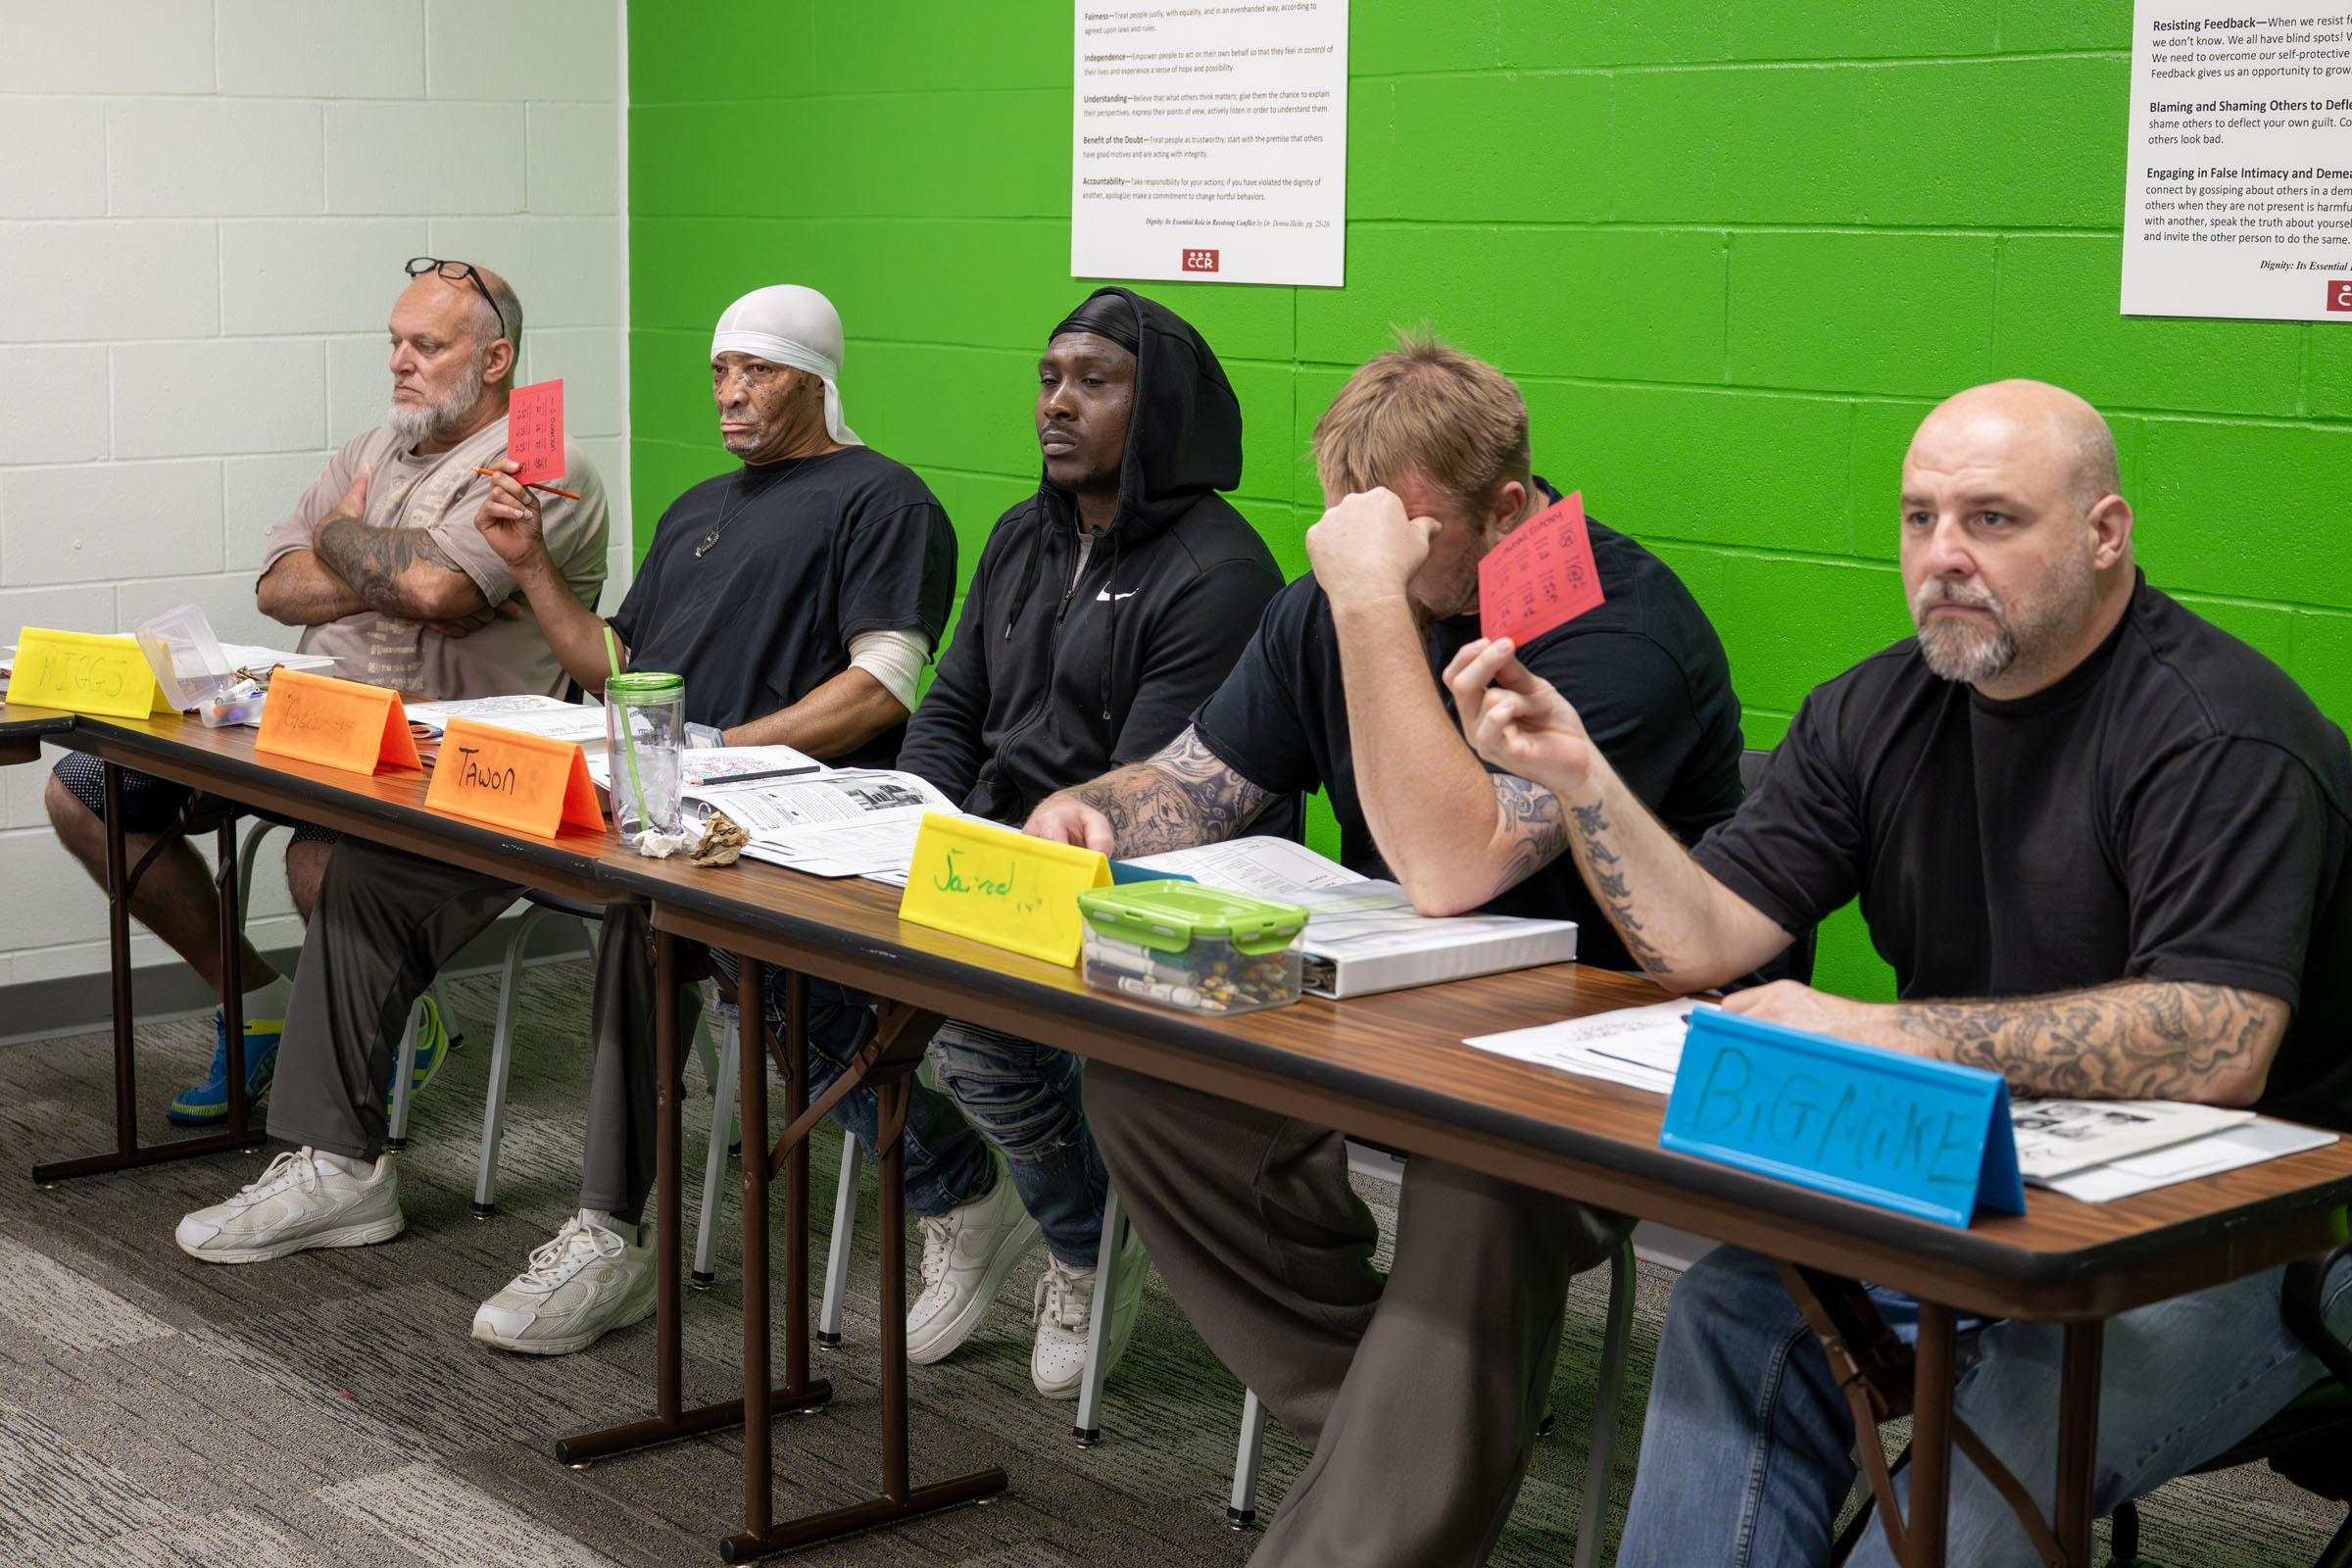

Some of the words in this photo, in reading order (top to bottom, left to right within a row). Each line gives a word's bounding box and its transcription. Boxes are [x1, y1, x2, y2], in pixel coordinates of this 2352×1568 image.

[2153, 19, 2200, 34] Resisting
[2300, 18, 2314, 26] we
[2317, 14, 2343, 25] resist
[2168, 36, 2193, 46] don’t
[2196, 35, 2224, 46] know.
[2228, 34, 2243, 45] We
[2246, 34, 2257, 44] all
[2260, 33, 2283, 44] have
[2286, 32, 2310, 43] blind
[2313, 31, 2343, 44] spots!
[2152, 52, 2167, 63] We
[2170, 52, 2193, 62] need
[2196, 51, 2206, 61] to
[2208, 53, 2256, 61] overcome
[2278, 48, 2350, 62] self-protective
[2151, 67, 2195, 78] Feedback
[2197, 67, 2221, 79] gives
[2251, 65, 2309, 78] opportunity
[2313, 65, 2323, 75] to
[2325, 67, 2352, 77] grow.
[2150, 101, 2192, 115] Blaming
[2196, 101, 2216, 112] and
[2219, 100, 2266, 114] Shaming
[2270, 100, 2307, 111] Others
[2310, 99, 2322, 110] to
[2149, 119, 2179, 129] shame
[2182, 118, 2212, 128] others
[2215, 118, 2225, 128] to
[2227, 118, 2260, 128] deflect
[2263, 120, 2285, 130] your
[2311, 117, 2336, 130] guilt.
[2148, 134, 2178, 144] others
[2180, 134, 2200, 144] look
[2203, 134, 2223, 144] bad.
[2147, 167, 2194, 180] Engaging
[2197, 167, 2207, 178] in
[2210, 167, 2237, 178] False
[2241, 167, 2288, 181] Intimacy
[2292, 168, 2312, 179] and
[2146, 185, 2183, 195] connect
[2185, 185, 2196, 197] by
[2199, 185, 2243, 197] gossiping
[2245, 185, 2273, 195] about
[2276, 186, 2308, 196] others
[2310, 186, 2319, 196] in
[2145, 200, 2175, 210] others
[2178, 200, 2203, 210] when
[2206, 201, 2227, 213] they
[2247, 201, 2264, 211] not
[2266, 201, 2304, 214] present
[2306, 202, 2314, 211] is
[2145, 216, 2165, 226] with
[2167, 216, 2207, 229] another,
[2210, 216, 2237, 229] speak
[2240, 217, 2255, 227] the
[2258, 217, 2282, 227] truth
[2285, 218, 2313, 228] about
[2144, 231, 2161, 241] and
[2163, 231, 2189, 241] invite
[2192, 232, 2207, 242] the
[2210, 232, 2235, 242] other
[2238, 235, 2271, 245] person
[2275, 233, 2284, 243] to
[2287, 234, 2299, 244] do
[2303, 234, 2319, 244] the
[1188, 258, 1213, 269] CCR
[2260, 260, 2293, 272] Dignity:
[2296, 260, 2306, 270] Its
[2309, 261, 2347, 271] Essential
